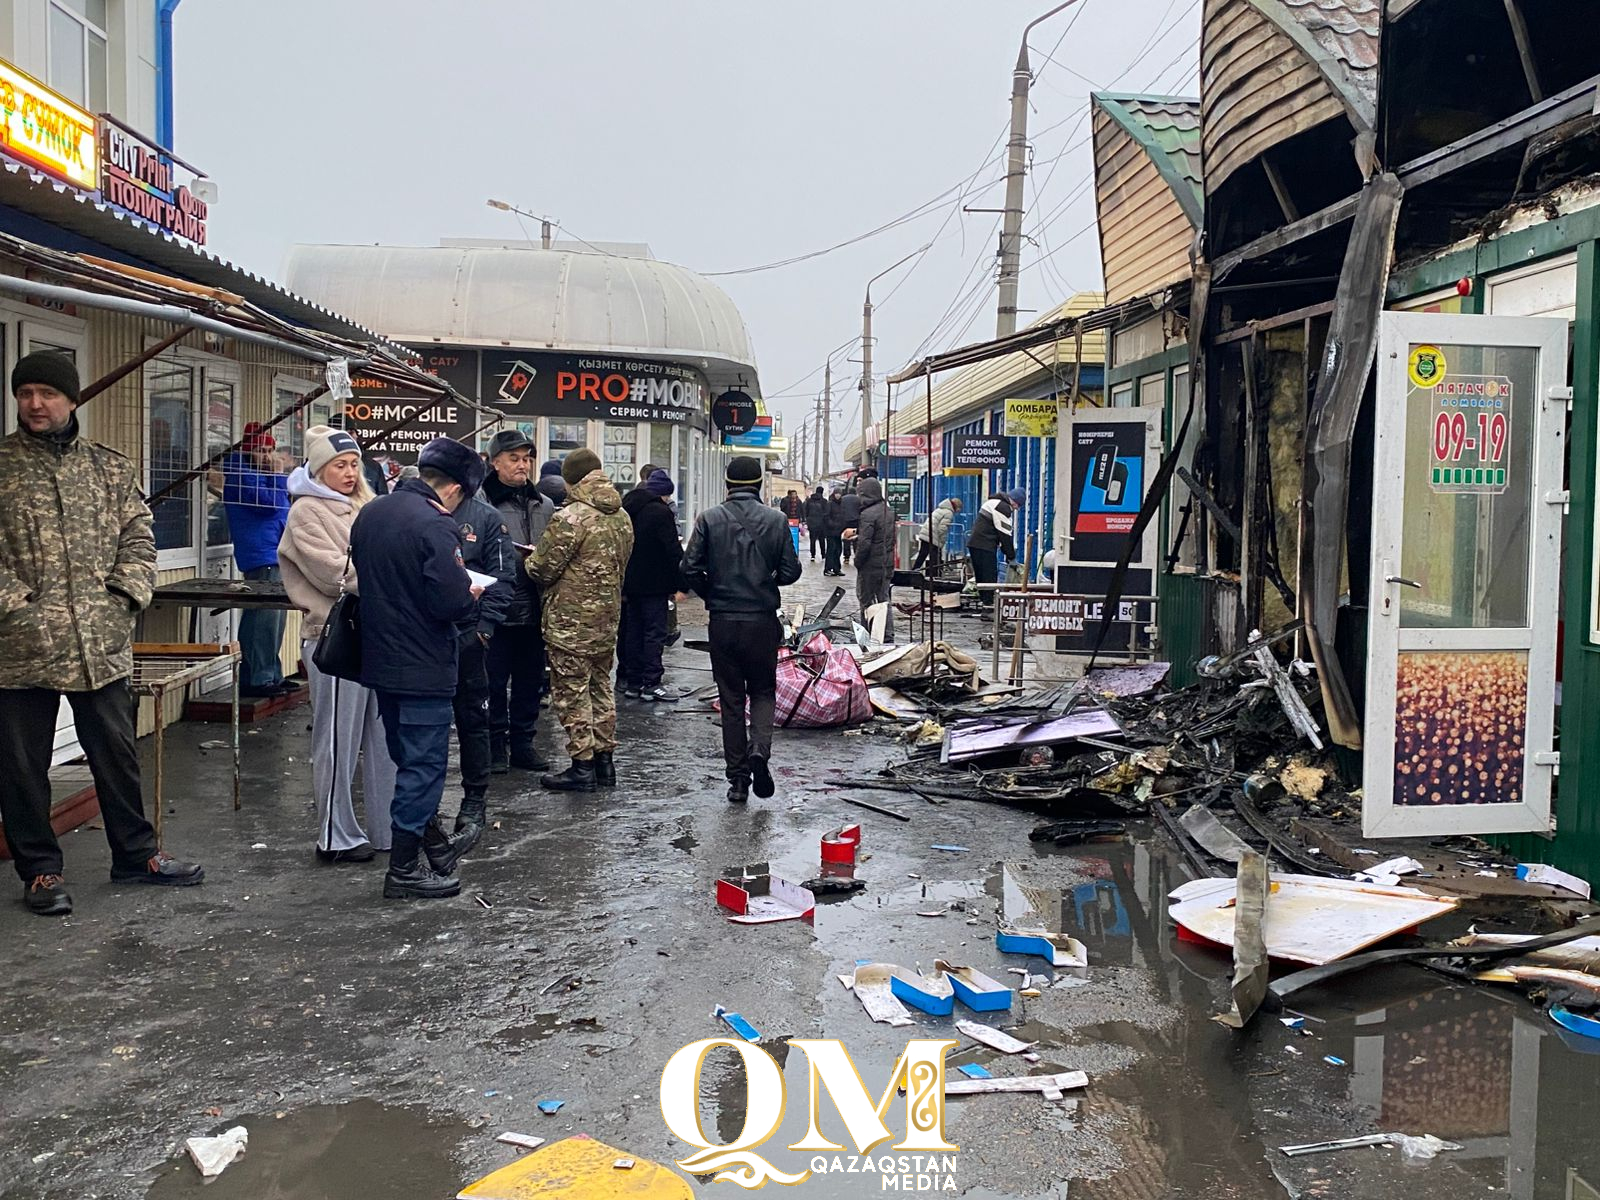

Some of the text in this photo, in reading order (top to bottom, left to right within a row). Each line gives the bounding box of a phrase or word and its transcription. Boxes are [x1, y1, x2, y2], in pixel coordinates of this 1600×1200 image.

[109, 128, 171, 192] City Print
[178, 185, 208, 222] Фото
[429, 356, 460, 367] САТУ
[578, 359, 622, 371] ҚЫЗМЕТ
[625, 362, 662, 374] КӨРСЕТУ
[557, 371, 701, 410] PRO#MOBIL
[342, 403, 458, 424] RO#MOBILE
[609, 407, 686, 421] СЕРВИС И РЕМОНТ
[731, 408, 738, 424] 1
[1009, 404, 1058, 415] ЛОМБАРД
[390, 429, 437, 441] РЕМОНТ
[1434, 411, 1507, 462] 09-19
[965, 439, 998, 447] РЕМОНТ
[961, 448, 1001, 456] СОТОВЫХ
[957, 456, 1006, 464] ТЕЛЕФОНОВ
[1034, 598, 1082, 614] РЕМОНТ
[1029, 615, 1083, 631] СОТОВЫХ
